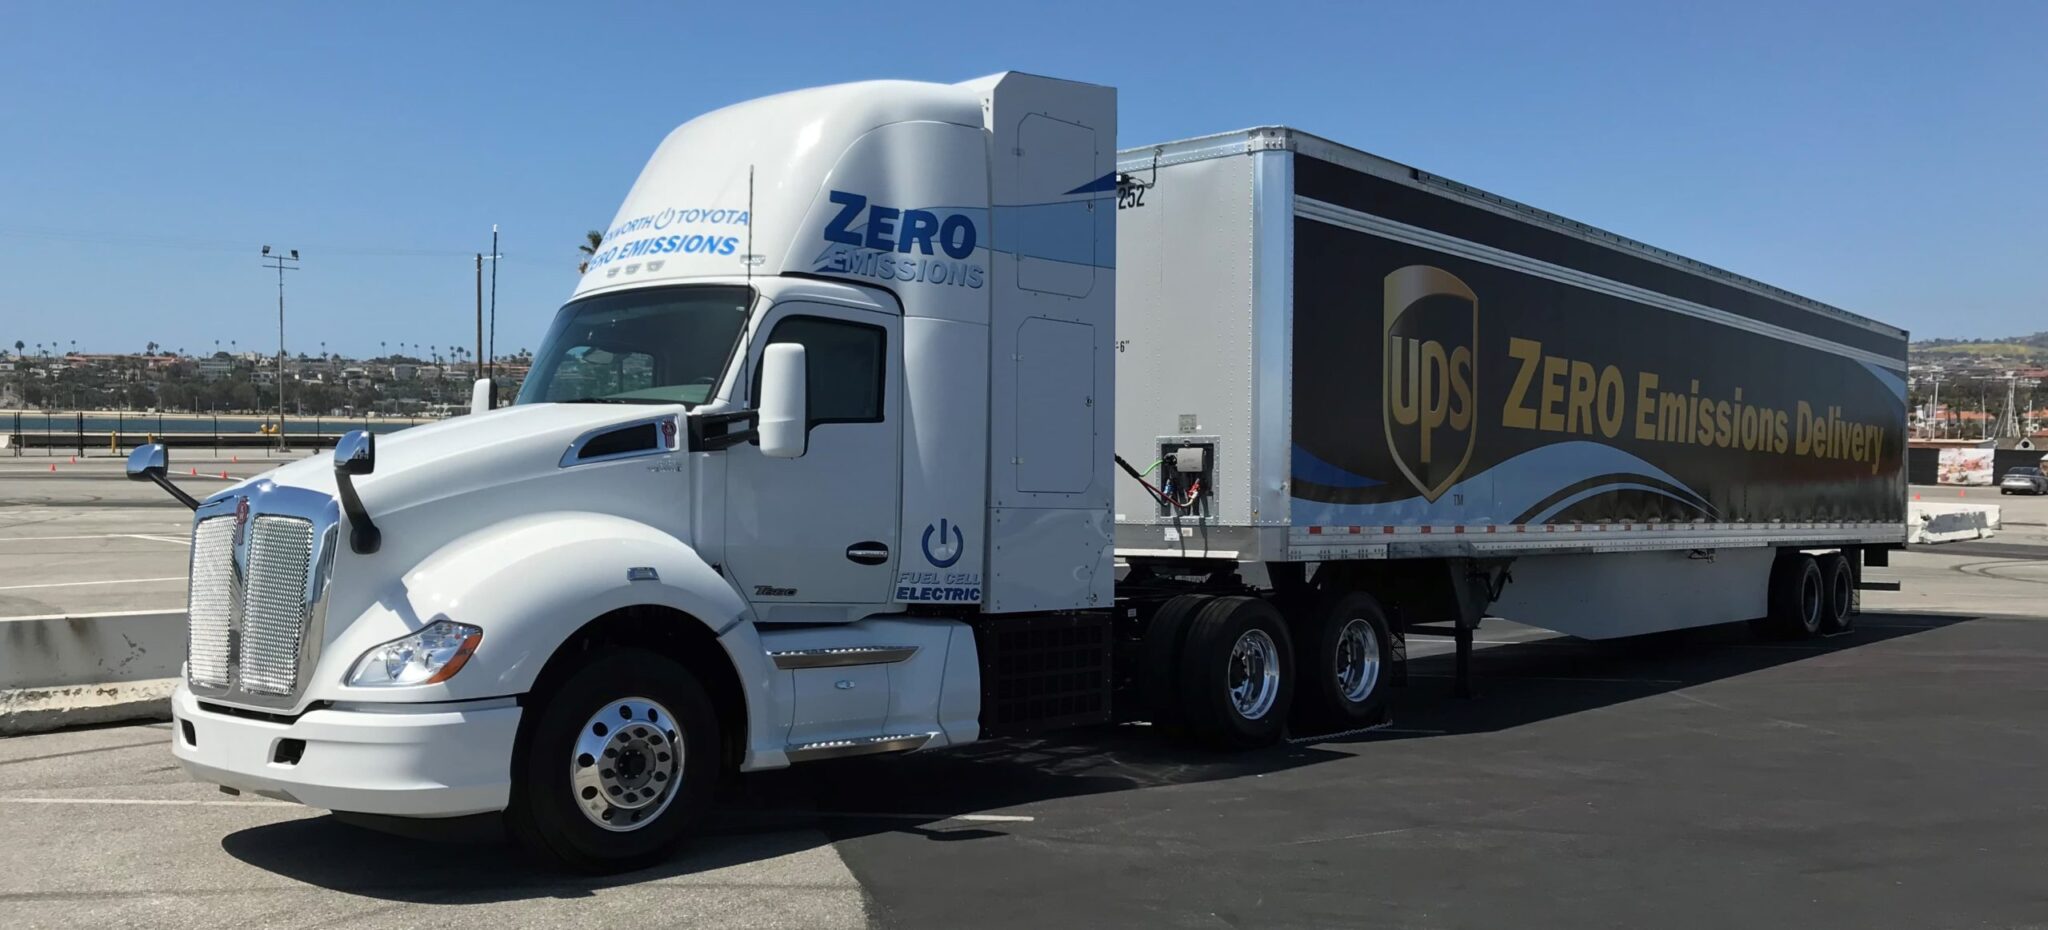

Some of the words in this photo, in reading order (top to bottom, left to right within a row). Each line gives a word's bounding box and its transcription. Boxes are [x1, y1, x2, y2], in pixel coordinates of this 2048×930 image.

[1118, 184, 1145, 210] 252
[677, 208, 749, 226] TOYOTA
[823, 190, 977, 260] ZERO
[617, 235, 740, 261] EMISSIONS
[828, 250, 984, 289] EMISSIONS
[1391, 335, 1472, 463] ups
[1502, 336, 1625, 439] ZERO
[1635, 371, 1789, 455] Emissions
[1795, 399, 1885, 476] Delivery
[896, 572, 940, 585] FUEL
[945, 573, 981, 586] CELL
[896, 586, 981, 601] ELECTRIC
